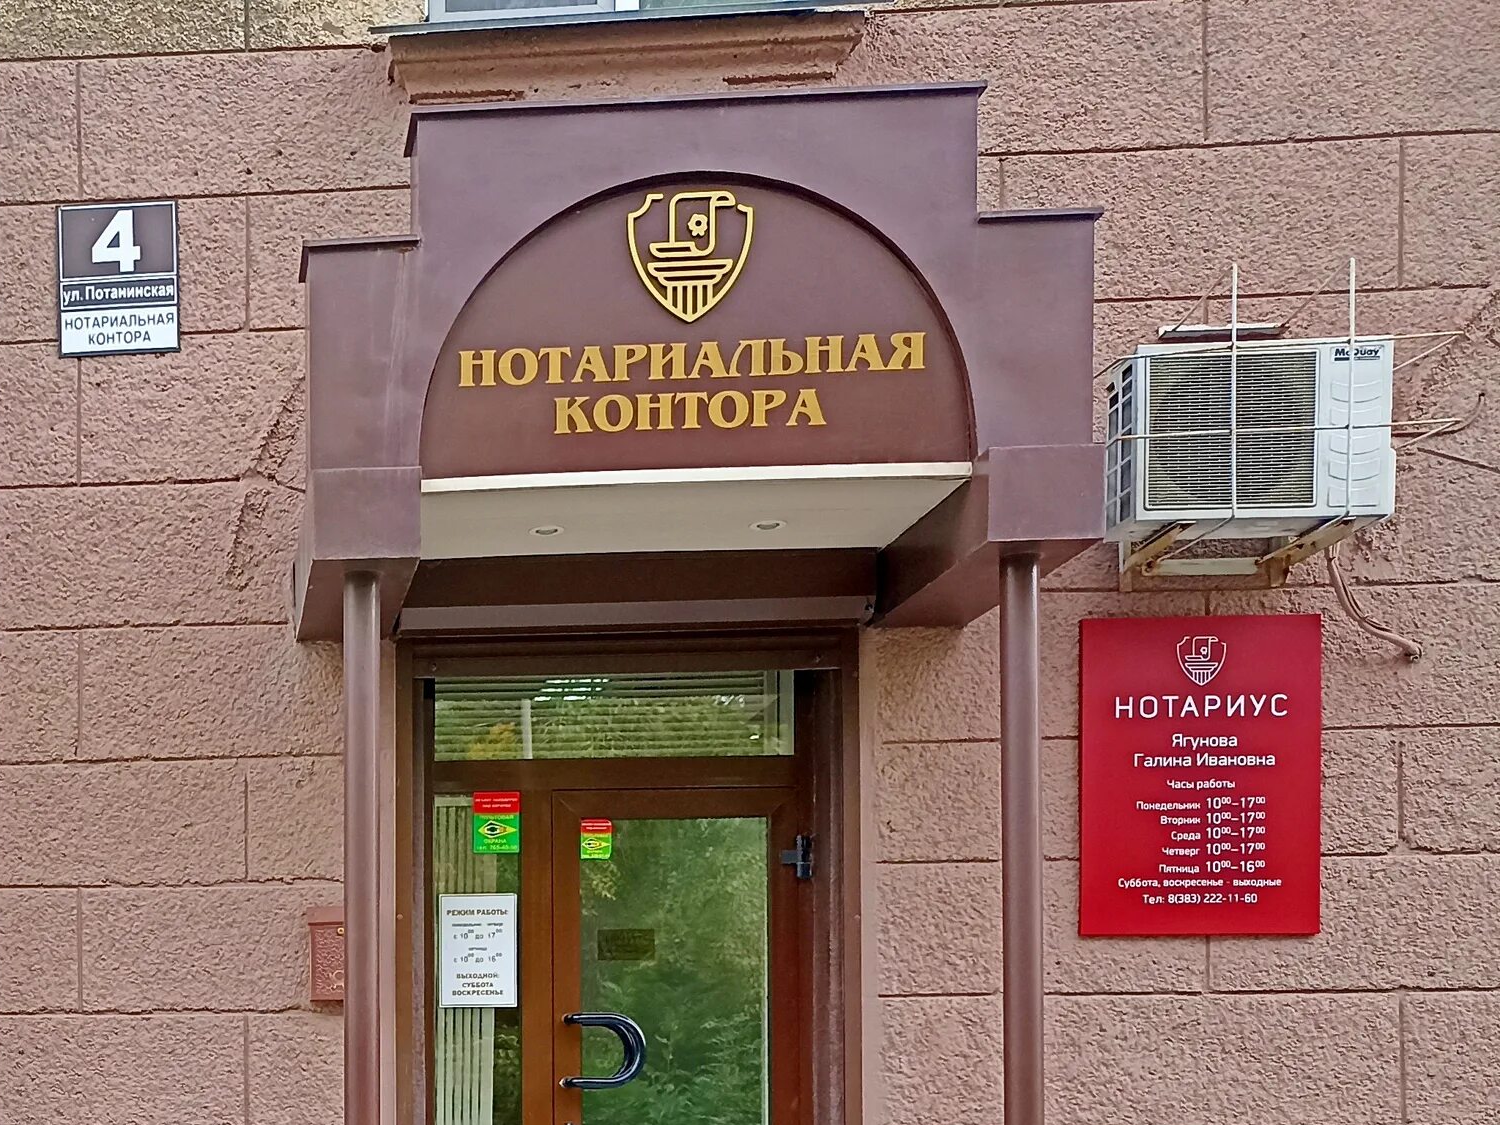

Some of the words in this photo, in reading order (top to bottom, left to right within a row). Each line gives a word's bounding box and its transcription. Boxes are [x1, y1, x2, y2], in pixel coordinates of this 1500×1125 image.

[91, 209, 141, 273] 4
[85, 284, 174, 300] Потанинская
[64, 312, 174, 330] НОТАРИАЛЬНАЯ
[88, 330, 151, 346] КОНТОРА
[457, 331, 926, 388] НОТАРИАЛЬНАЯ
[553, 388, 827, 435] КОНТОРА
[1115, 693, 1289, 719] НОТАРИУС
[1171, 733, 1238, 751] Ягунова
[1133, 753, 1192, 768] Галина
[1196, 752, 1276, 766] Ивановна
[1167, 779, 1195, 790] Часы
[1196, 778, 1236, 791] работы
[1136, 800, 1201, 812] Понедельник
[1160, 815, 1201, 826] Вторник
[1171, 830, 1201, 842] Среда
[1162, 847, 1200, 858] Четверг
[1158, 863, 1200, 875] Пятница
[1118, 877, 1161, 889] Суббота,
[1163, 878, 1224, 888] воскресенье
[1233, 878, 1282, 888] выходные
[1142, 894, 1165, 905] Тел:
[1167, 893, 1201, 905] 8(383)
[1203, 893, 1258, 904] 222-11-60
